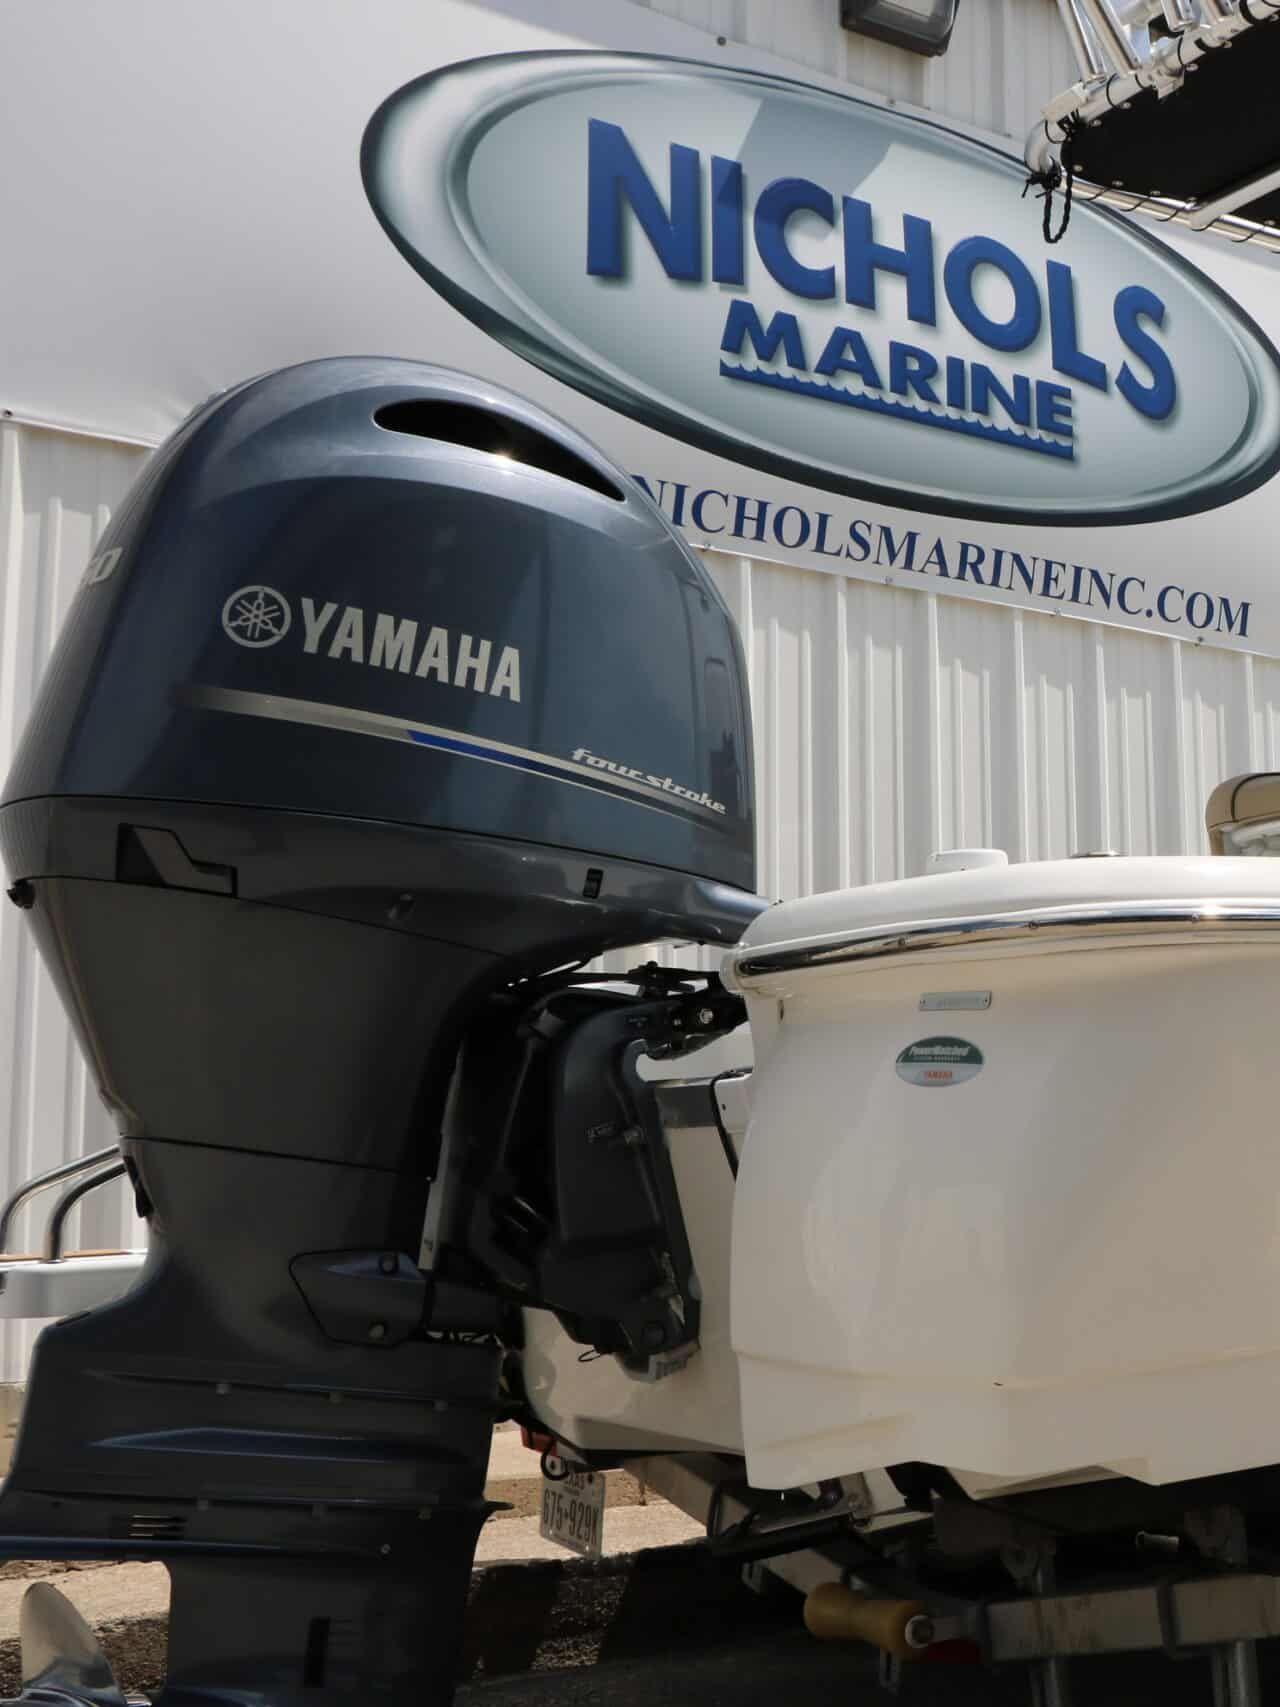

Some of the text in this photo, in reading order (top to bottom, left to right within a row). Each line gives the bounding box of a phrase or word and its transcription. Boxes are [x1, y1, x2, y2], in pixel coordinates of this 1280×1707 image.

[586, 117, 1178, 421] NICHOLS
[719, 299, 1074, 438] MARINE
[300, 597, 521, 702] YAMAHA
